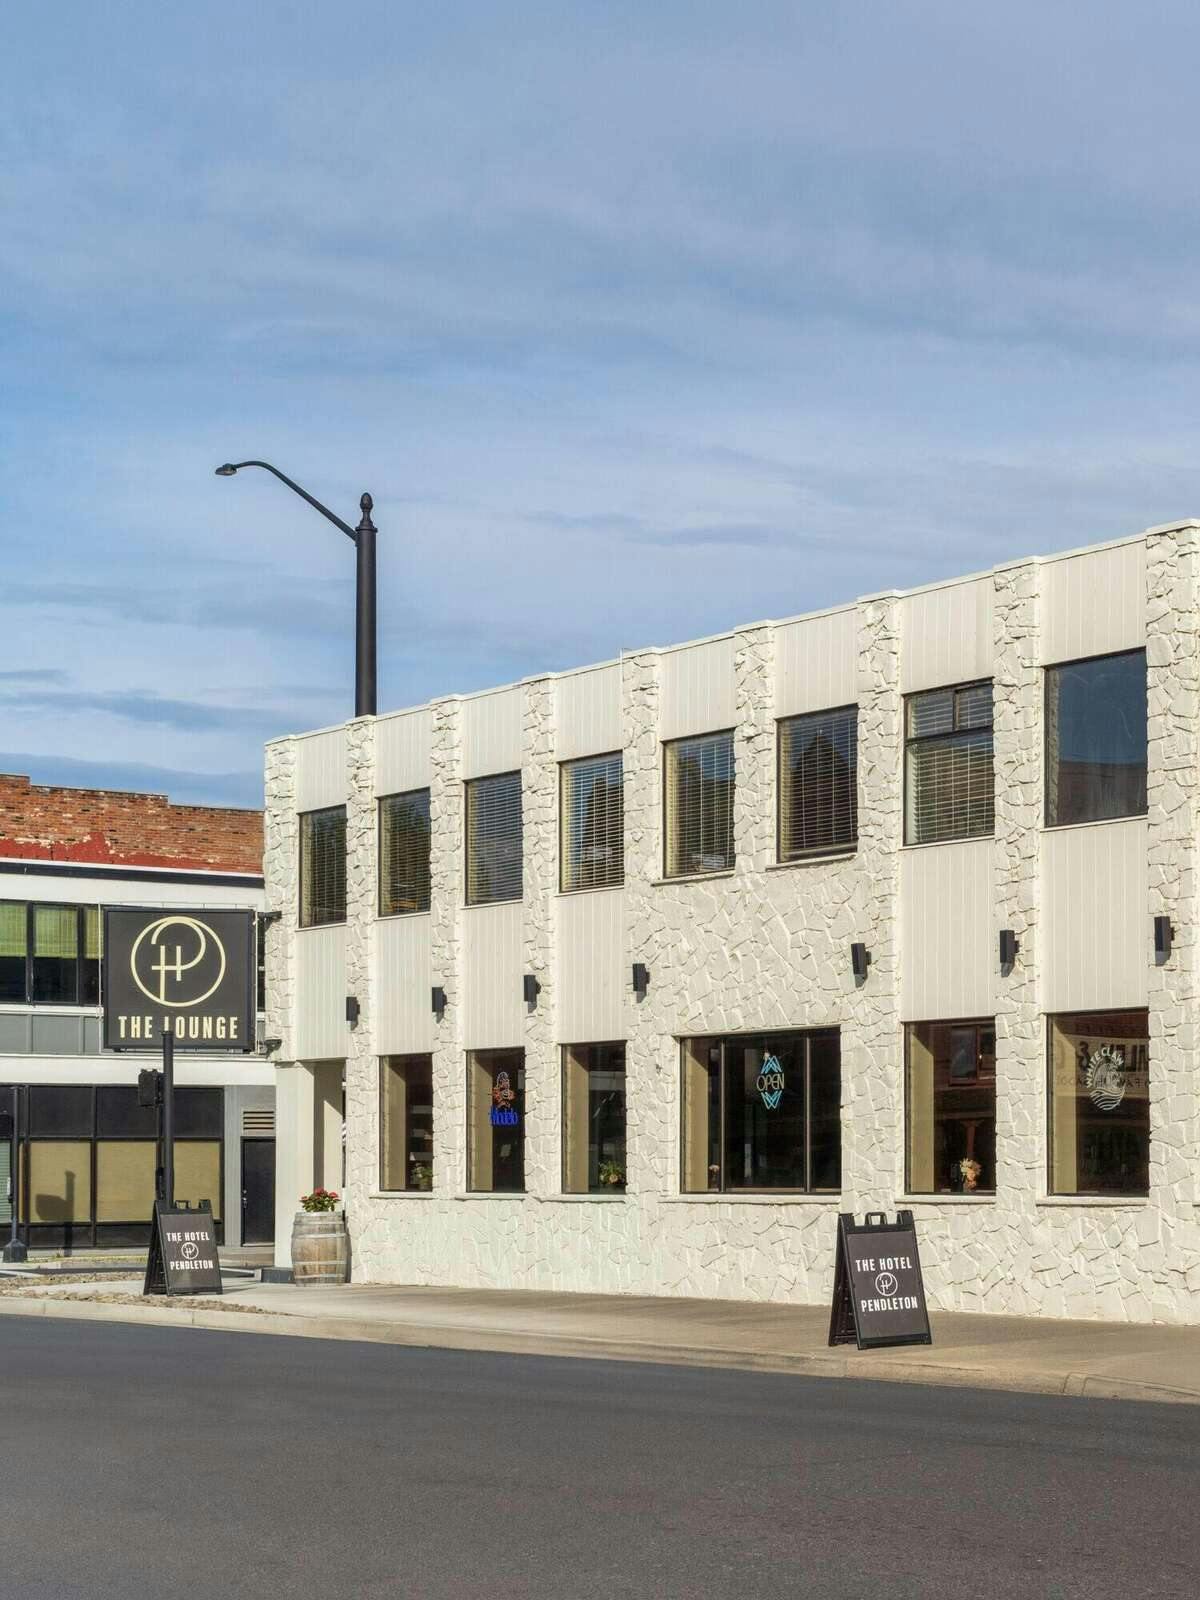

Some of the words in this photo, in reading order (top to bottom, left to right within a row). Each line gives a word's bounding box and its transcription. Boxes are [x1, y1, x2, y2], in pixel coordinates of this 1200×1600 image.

[118, 1016, 153, 1039] THE
[164, 1016, 238, 1039] LOUNGE
[1101, 1047, 1124, 1066] CLAW
[756, 1073, 785, 1091] OPEN
[166, 1232, 182, 1242] THE
[184, 1231, 210, 1241] HOTEL
[169, 1260, 214, 1270] PENDLETON
[855, 1258, 876, 1272] THE
[879, 1256, 912, 1271] HOTEL
[861, 1296, 918, 1313] PENDLETON
